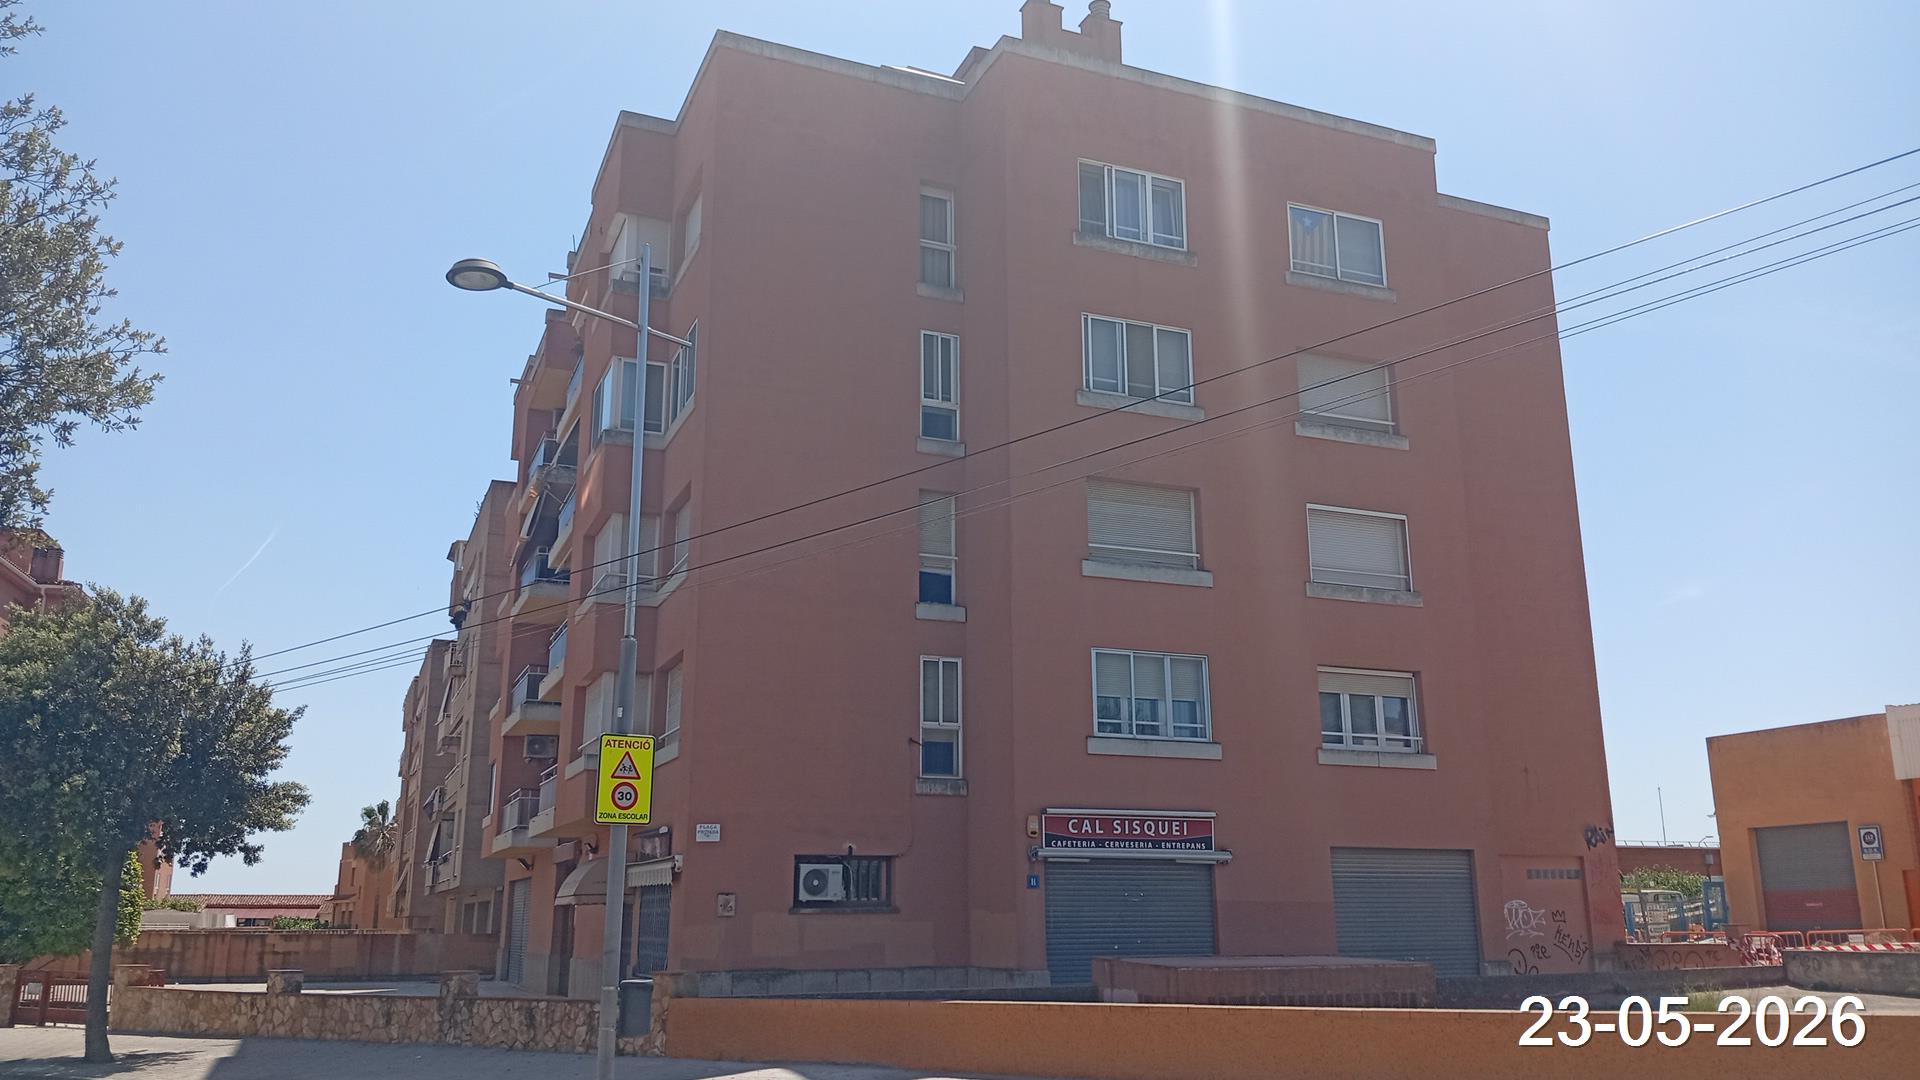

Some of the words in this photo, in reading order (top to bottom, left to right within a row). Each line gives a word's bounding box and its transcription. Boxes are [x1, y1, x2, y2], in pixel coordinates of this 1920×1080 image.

[604, 739, 651, 750] ATENCIÓ
[617, 791, 632, 801] 30
[1068, 819, 1104, 833] CAL
[1113, 820, 1188, 836] SISQUEI
[1051, 840, 1096, 848] CAFETERIA
[1105, 841, 1153, 849] CERVESERIA
[1161, 842, 1206, 850] ENTREPANS
